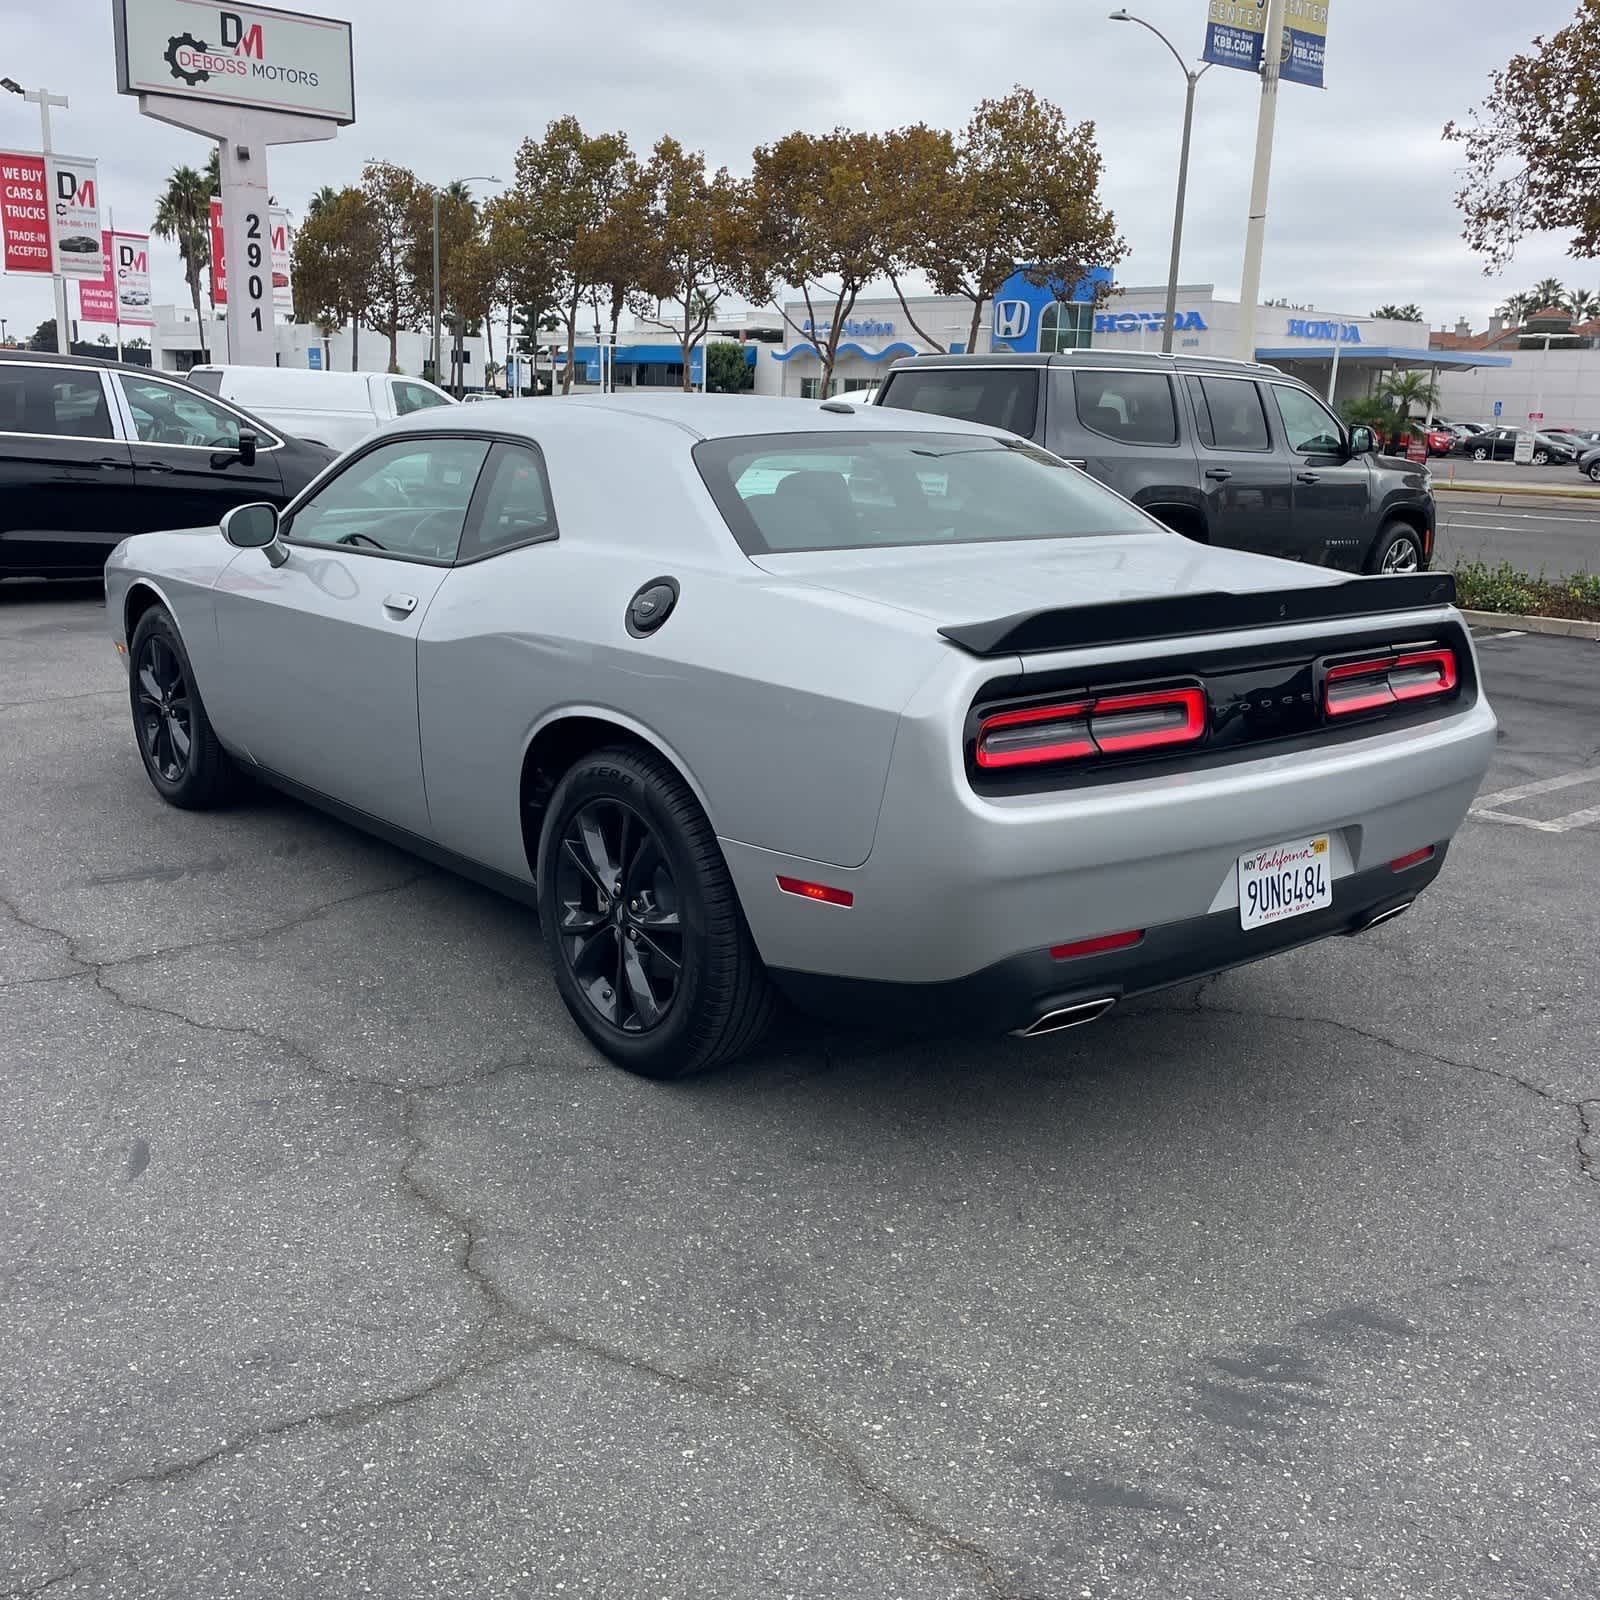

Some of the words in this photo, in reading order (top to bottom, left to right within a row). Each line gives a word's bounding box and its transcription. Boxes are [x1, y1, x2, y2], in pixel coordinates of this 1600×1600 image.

[1209, 2, 1262, 27] CENTER
[1284, 0, 1327, 24] ENTER
[220, 11, 264, 60] DM
[1213, 34, 1254, 54] KBB.COM
[1292, 46, 1325, 64] KBB.COM
[179, 51, 247, 75] DEBOSS
[252, 63, 319, 87] MOTORS
[2, 166, 20, 180] WE
[21, 169, 42, 182] BUY
[6, 186, 33, 200] CARS
[35, 188, 43, 201] &
[57, 170, 95, 208] DM
[5, 204, 46, 220] TRUCKS
[8, 230, 46, 242] TRADE-IN
[8, 245, 48, 257] ACCEPTED
[120, 245, 146, 273] DM
[246, 213, 262, 332] 2901
[1287, 319, 1361, 343] HONDA
[1243, 859, 1257, 872] NOV
[1257, 848, 1314, 872] California
[1247, 863, 1326, 917] 9UNG484
